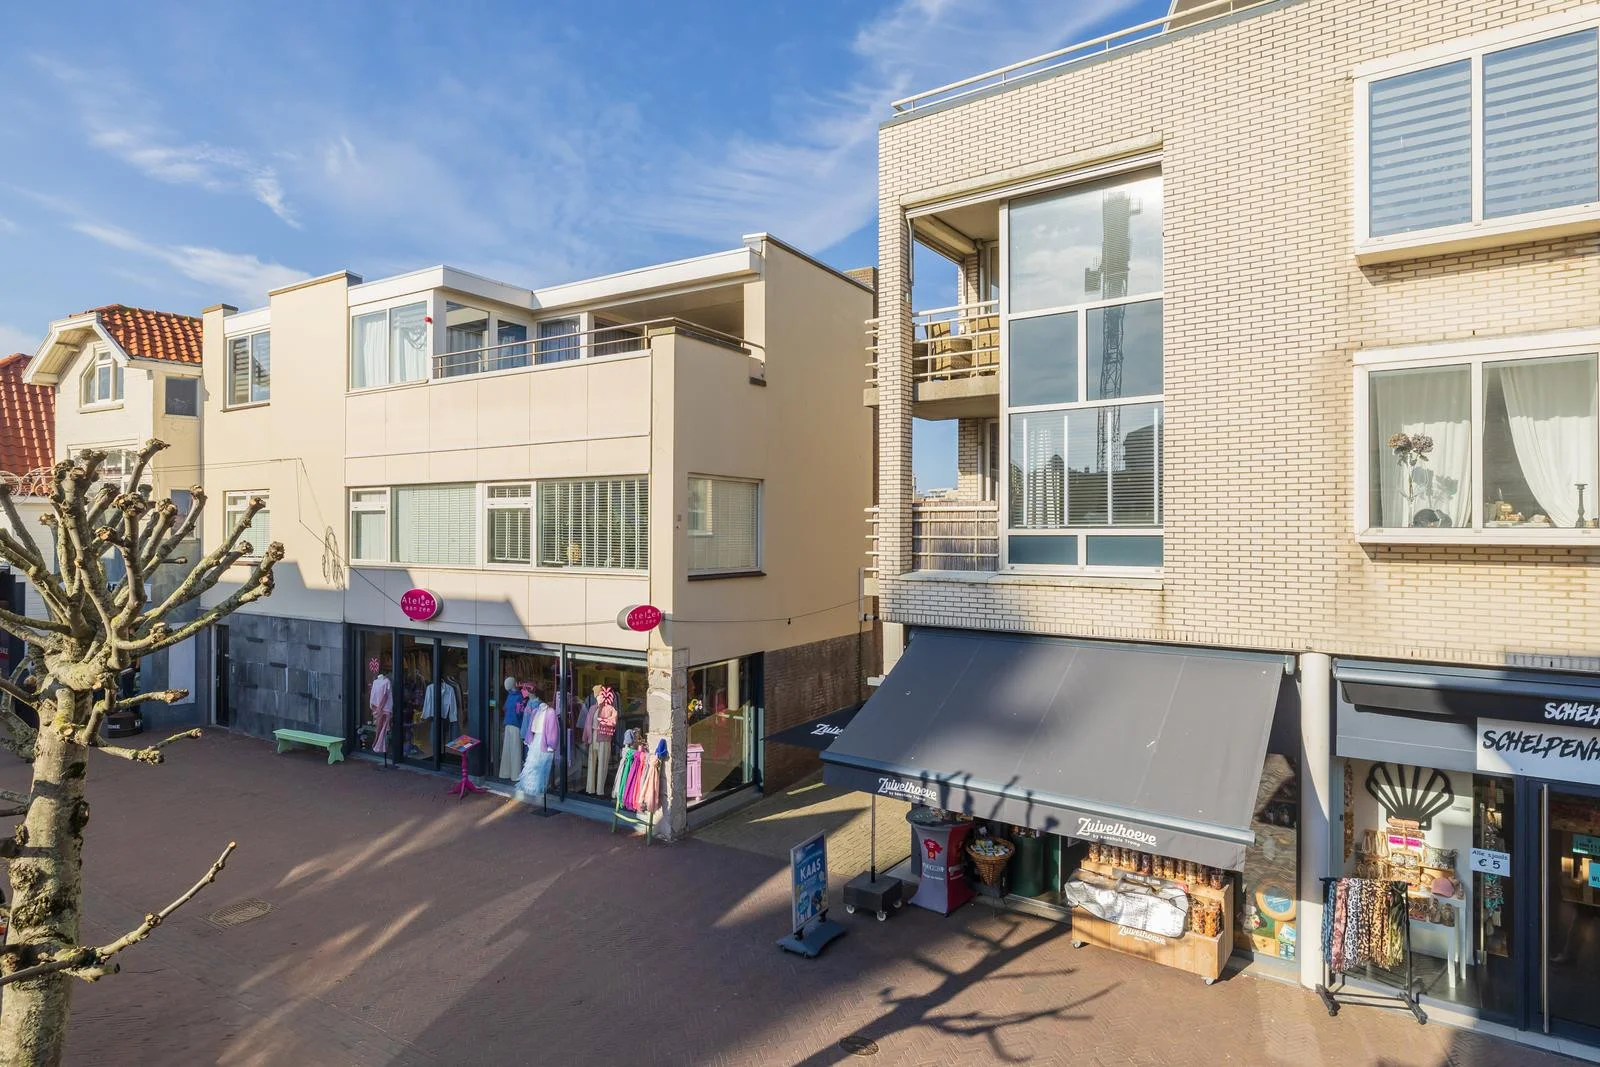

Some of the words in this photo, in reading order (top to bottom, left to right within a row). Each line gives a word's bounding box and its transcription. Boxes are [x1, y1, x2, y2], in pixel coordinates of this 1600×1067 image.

[878, 778, 937, 801] Zuivelhoeve
[1076, 817, 1157, 847] Zuivelhoeve
[800, 858, 821, 881] KAAS
[1493, 860, 1501, 870] 5
